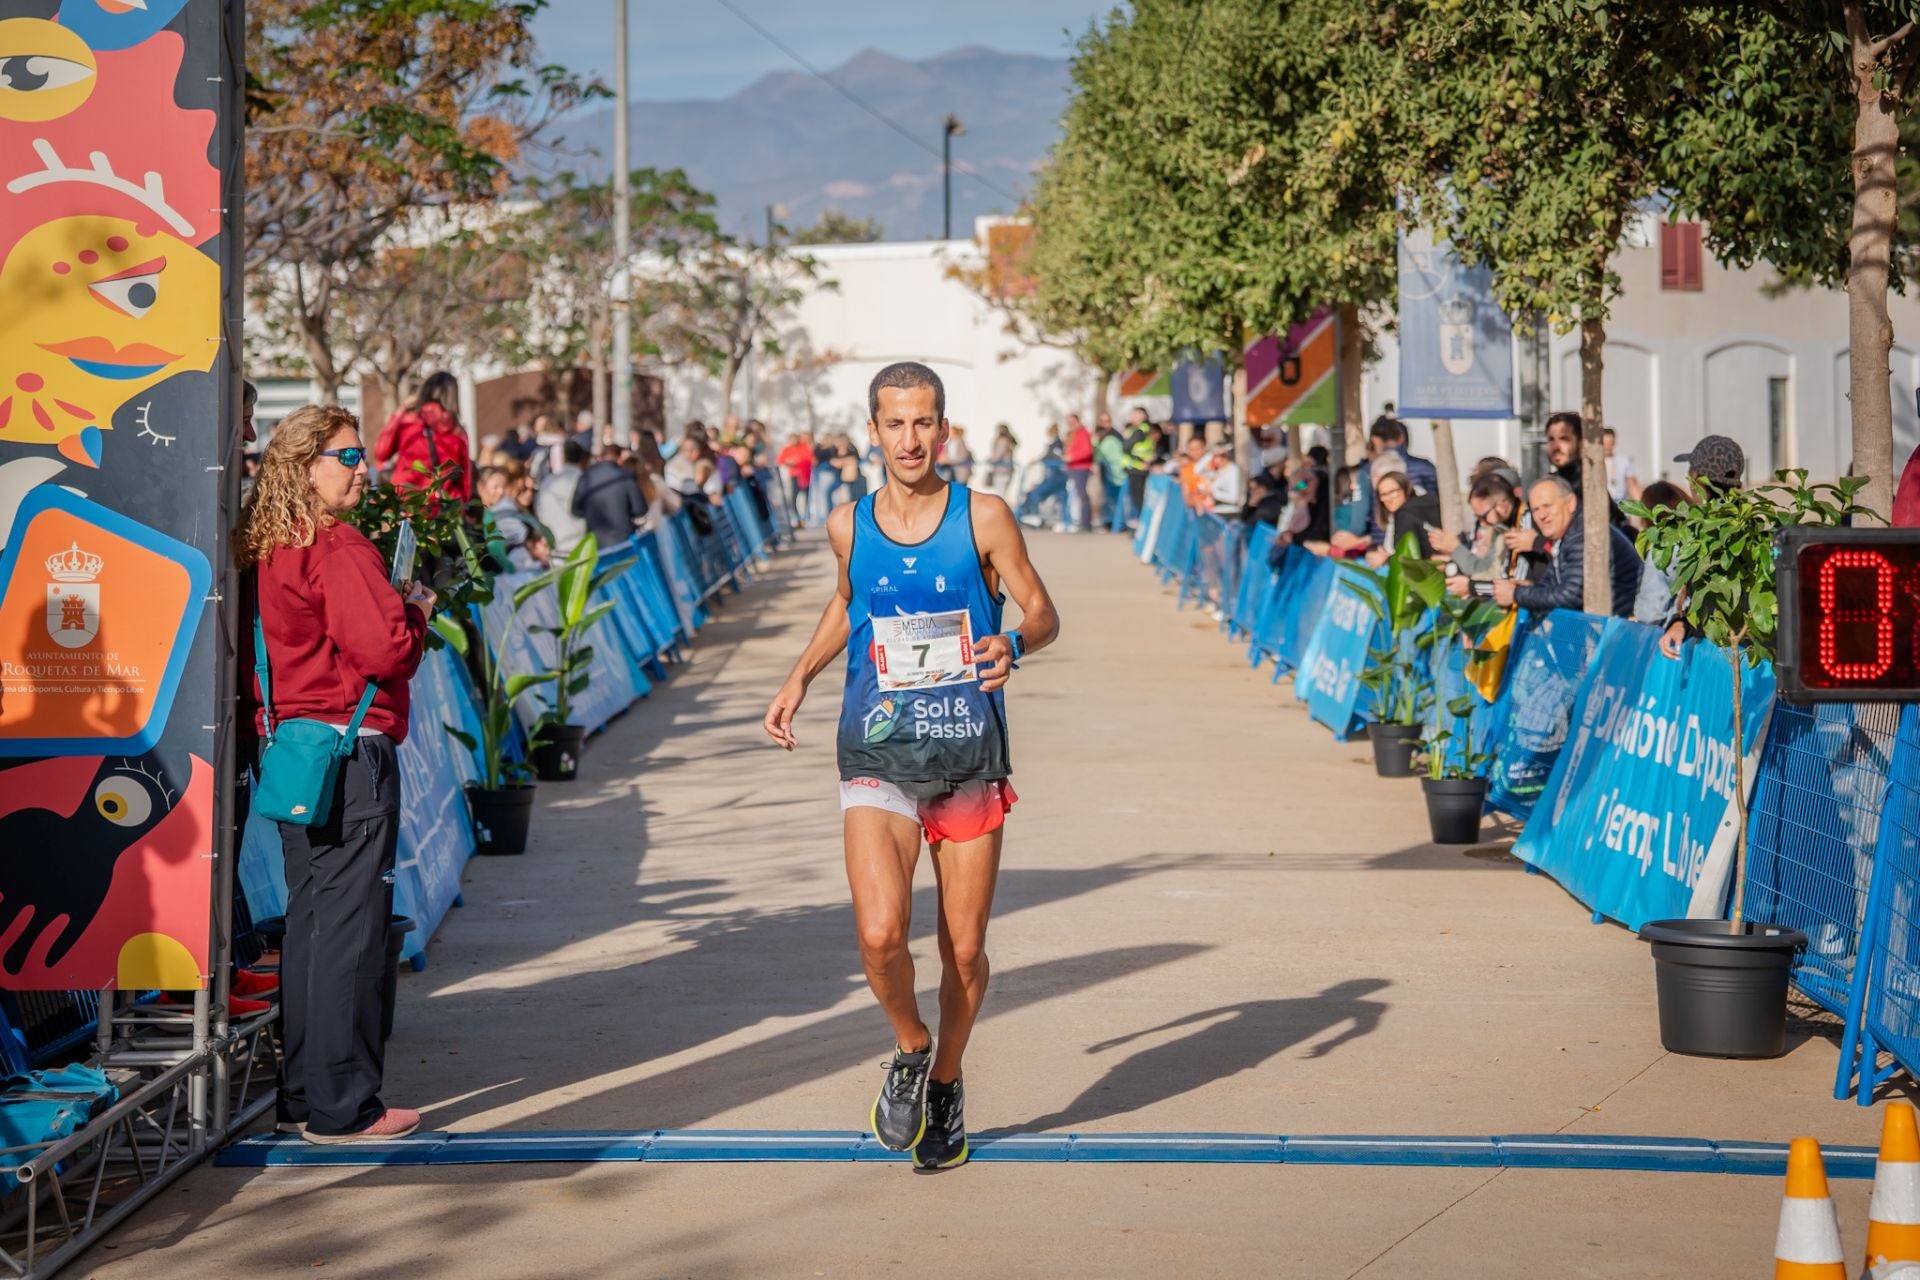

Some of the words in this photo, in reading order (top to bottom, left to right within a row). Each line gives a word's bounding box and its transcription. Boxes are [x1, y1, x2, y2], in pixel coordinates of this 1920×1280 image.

[901, 617, 937, 631] MEDIA
[26, 651, 104, 661] AYUNTAMIENTO
[106, 652, 119, 661] DE
[911, 643, 930, 668] 7
[3, 662, 77, 678] ROQUETAS
[83, 665, 100, 676] DE
[106, 663, 141, 677] MAR
[0, 685, 17, 693] rea
[18, 685, 28, 693] de
[64, 685, 91, 693] Cultura
[98, 685, 127, 695] Tiempo
[127, 685, 145, 694] Libre
[913, 697, 950, 719] Sol
[953, 697, 971, 717] &
[915, 718, 984, 740] Passiv
